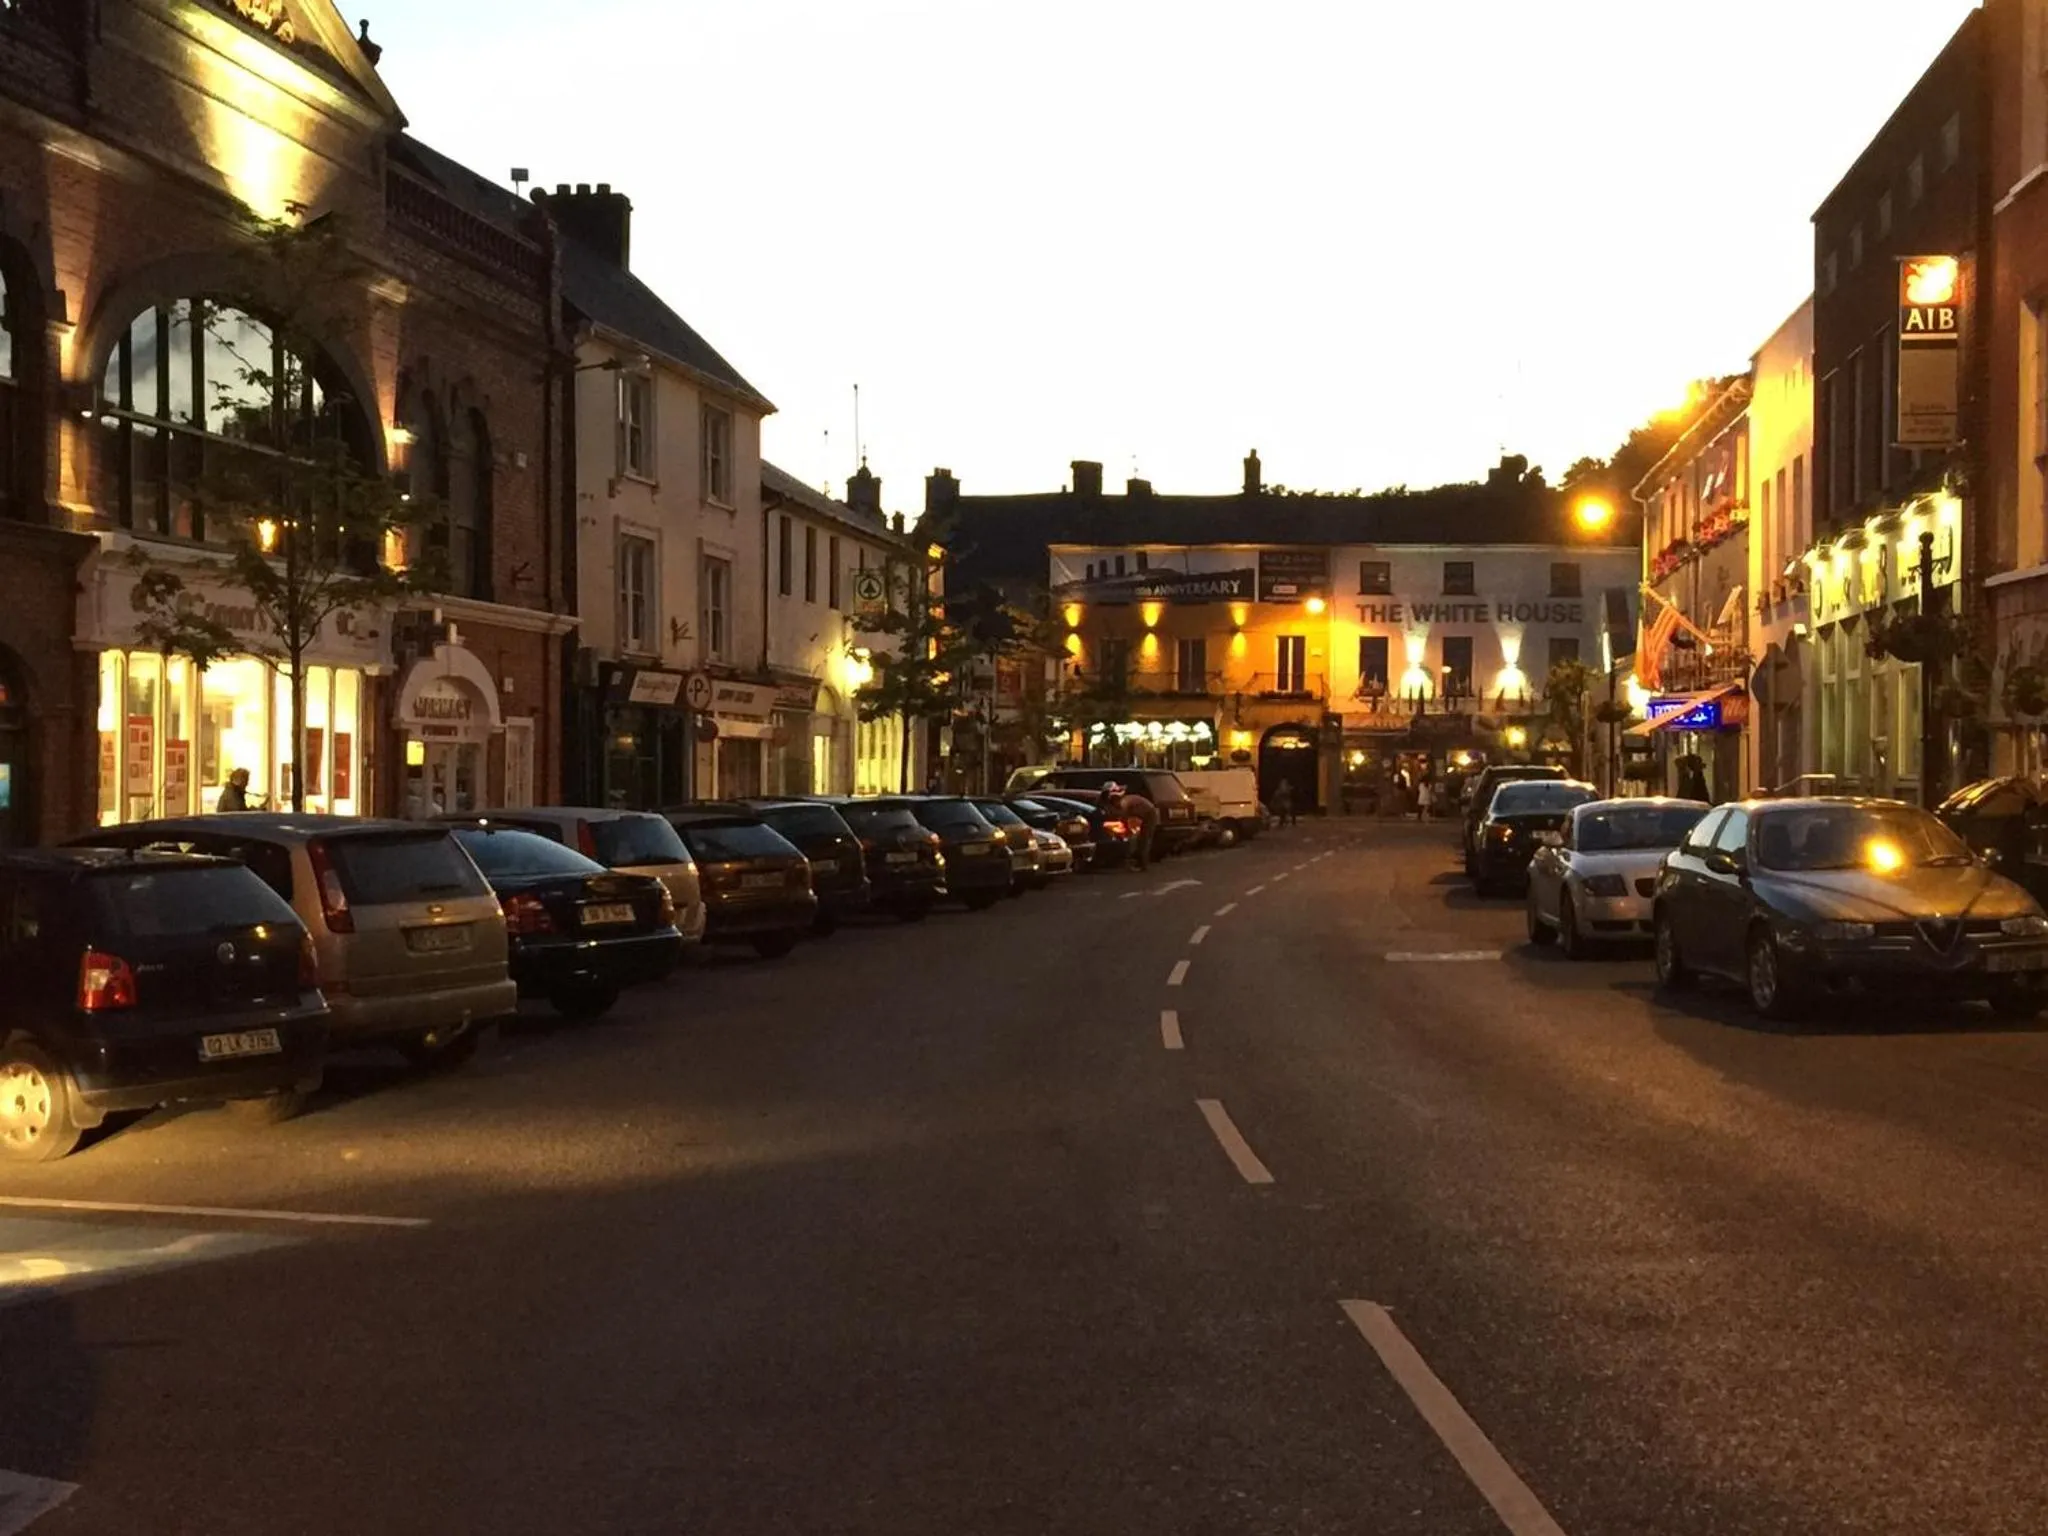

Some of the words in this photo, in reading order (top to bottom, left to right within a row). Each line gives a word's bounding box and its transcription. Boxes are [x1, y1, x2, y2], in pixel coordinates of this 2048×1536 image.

[1905, 308, 1955, 330] AIB
[1153, 579, 1242, 597] ANNIVERSARY
[1356, 604, 1402, 623] THE
[1410, 604, 1489, 623] WHITE
[1497, 603, 1583, 623] HOUSE
